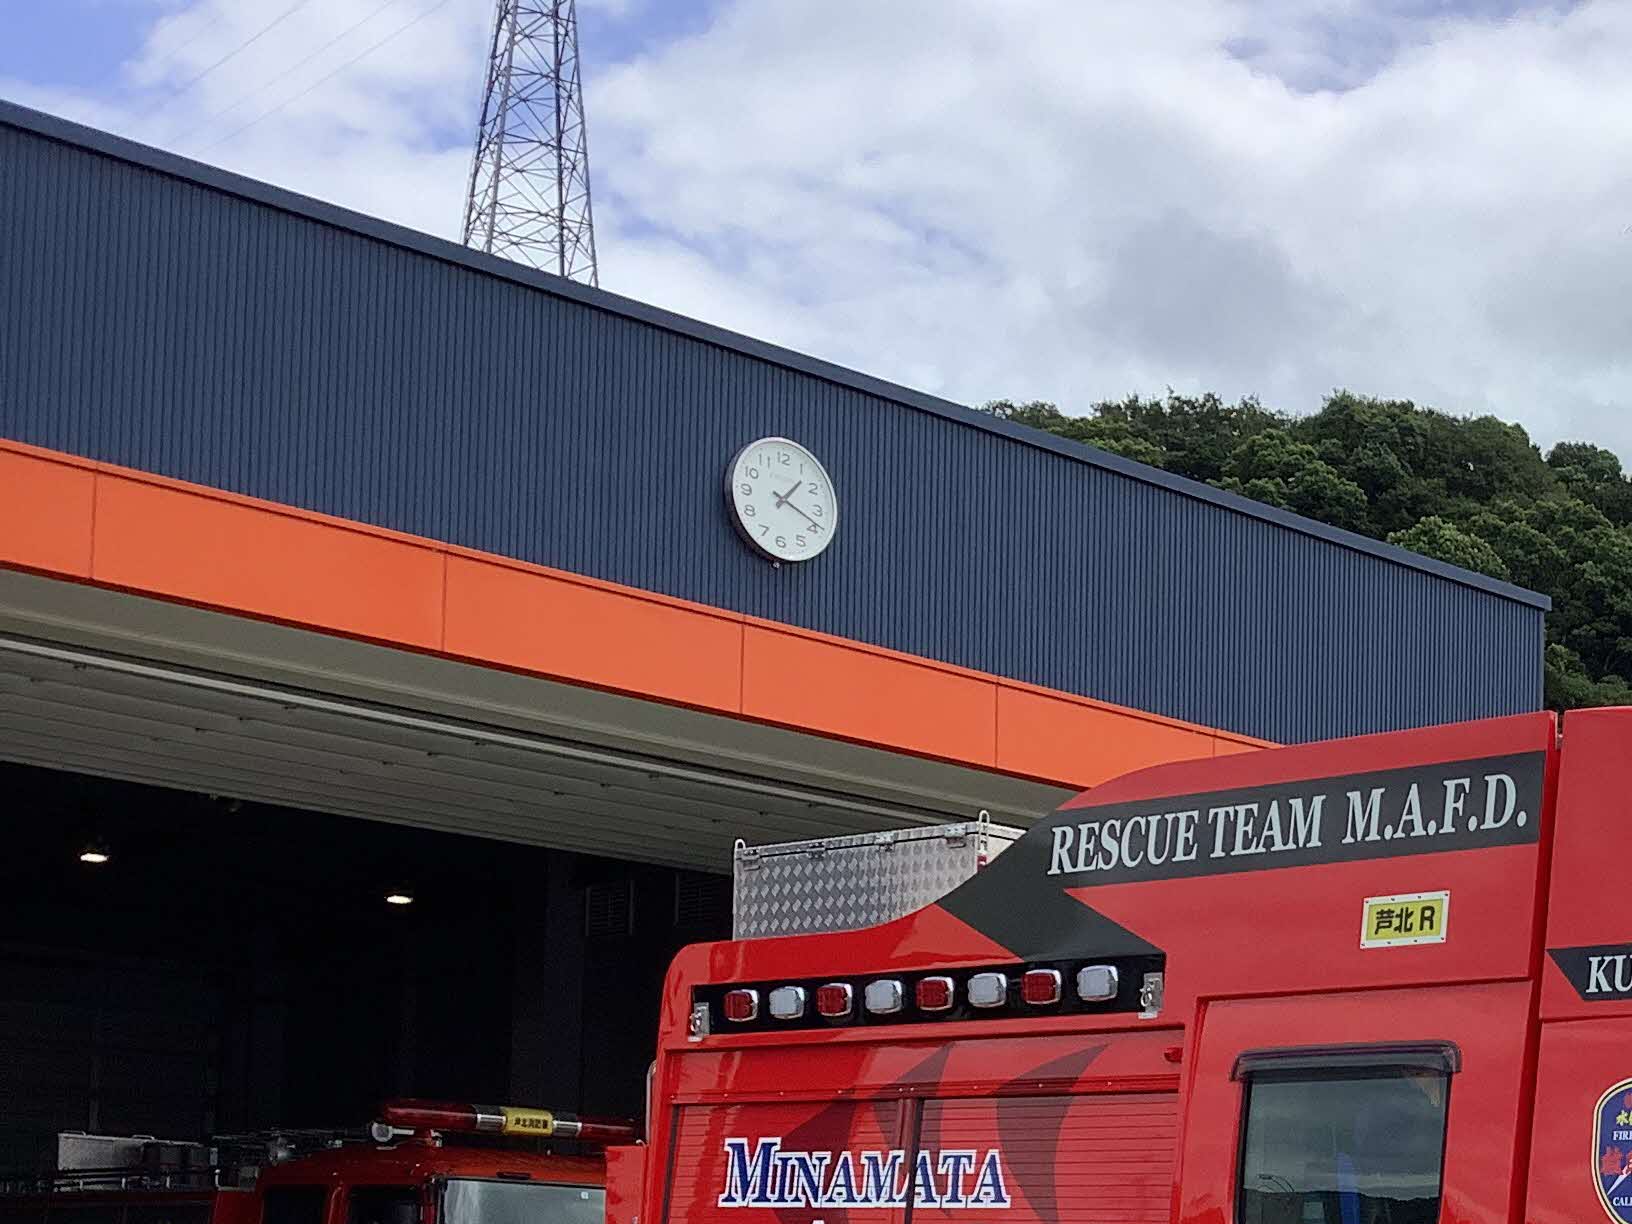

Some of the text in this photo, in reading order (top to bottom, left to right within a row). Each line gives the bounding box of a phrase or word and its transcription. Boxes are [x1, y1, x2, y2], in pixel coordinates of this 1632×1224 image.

[759, 454, 770, 468] 11
[777, 452, 790, 466] 12
[745, 466, 759, 479] 10
[741, 483, 752, 496] 9
[808, 483, 818, 495] 2
[744, 505, 755, 517] 8
[812, 505, 823, 517] 3
[758, 524, 769, 536] 7
[807, 524, 818, 534] 4
[776, 536, 786, 548] 6
[796, 534, 806, 547] 5
[1047, 774, 1527, 875] RESCUE TEAM M.A.F.D.
[1375, 905, 1435, 934] 芦北 R
